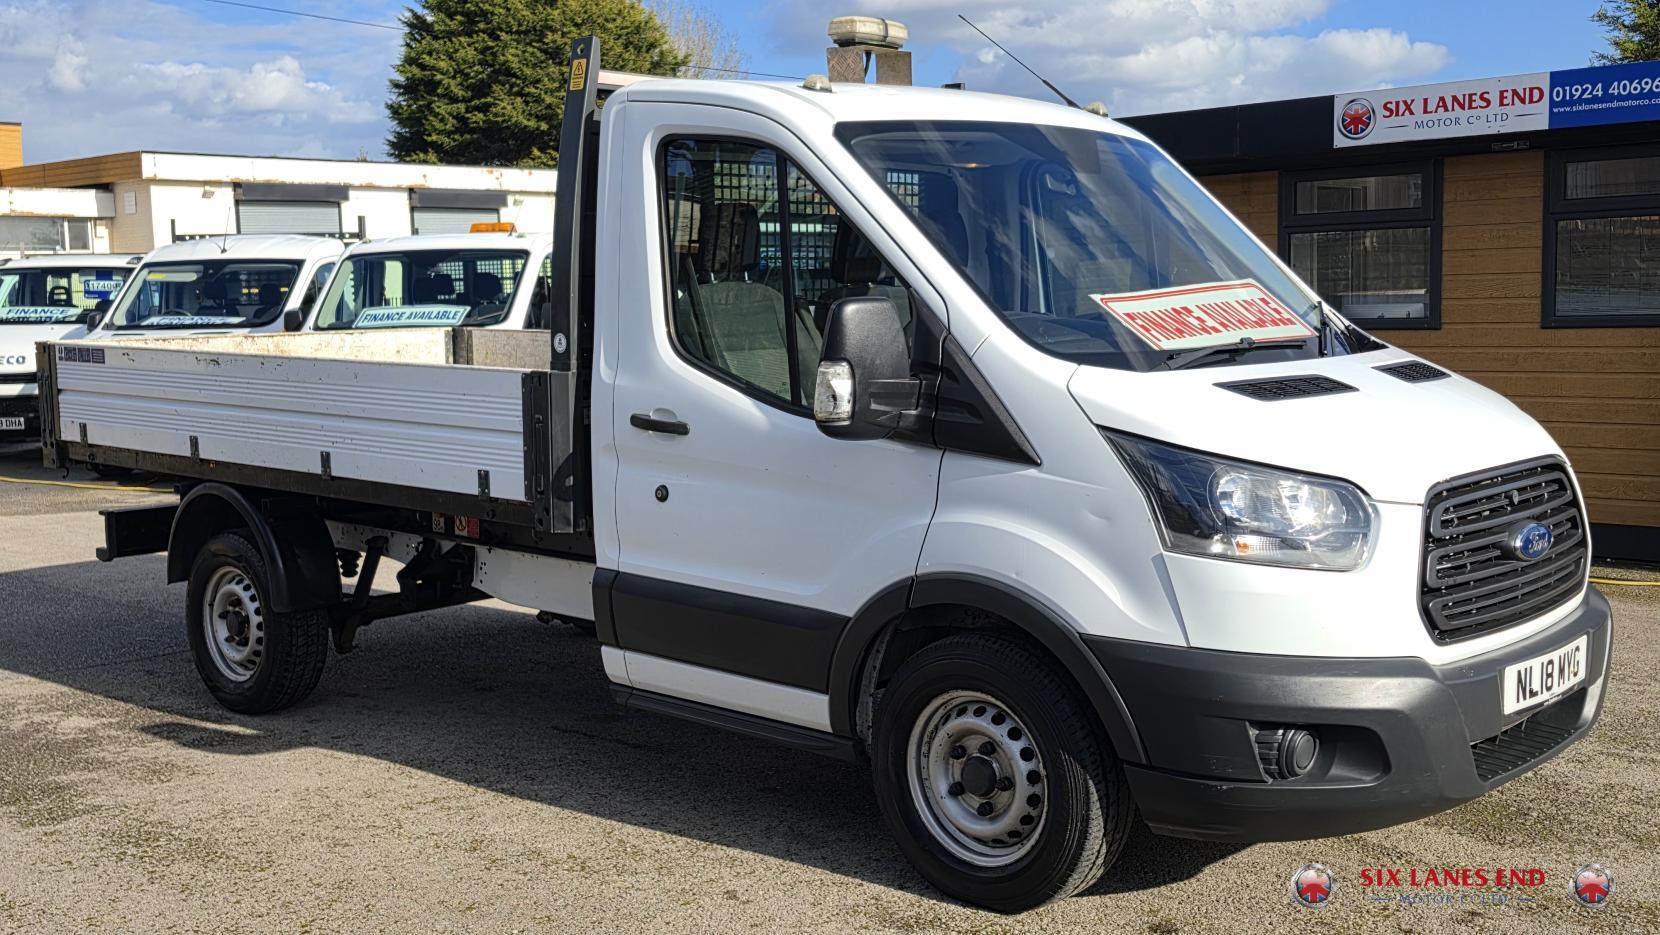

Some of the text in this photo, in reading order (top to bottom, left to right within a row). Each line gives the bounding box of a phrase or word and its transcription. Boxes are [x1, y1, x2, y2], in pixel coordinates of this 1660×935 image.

[1382, 86, 1545, 118] SIX LANES END
[1552, 83, 1603, 101] 01924
[1414, 116, 1461, 129] MOTOR
[1486, 112, 1509, 123] LTD
[361, 310, 459, 323] FINANCE AVAILABLE
[1122, 298, 1297, 342] FINANCE AVAILABLE
[1516, 645, 1580, 704] NL18 MYG
